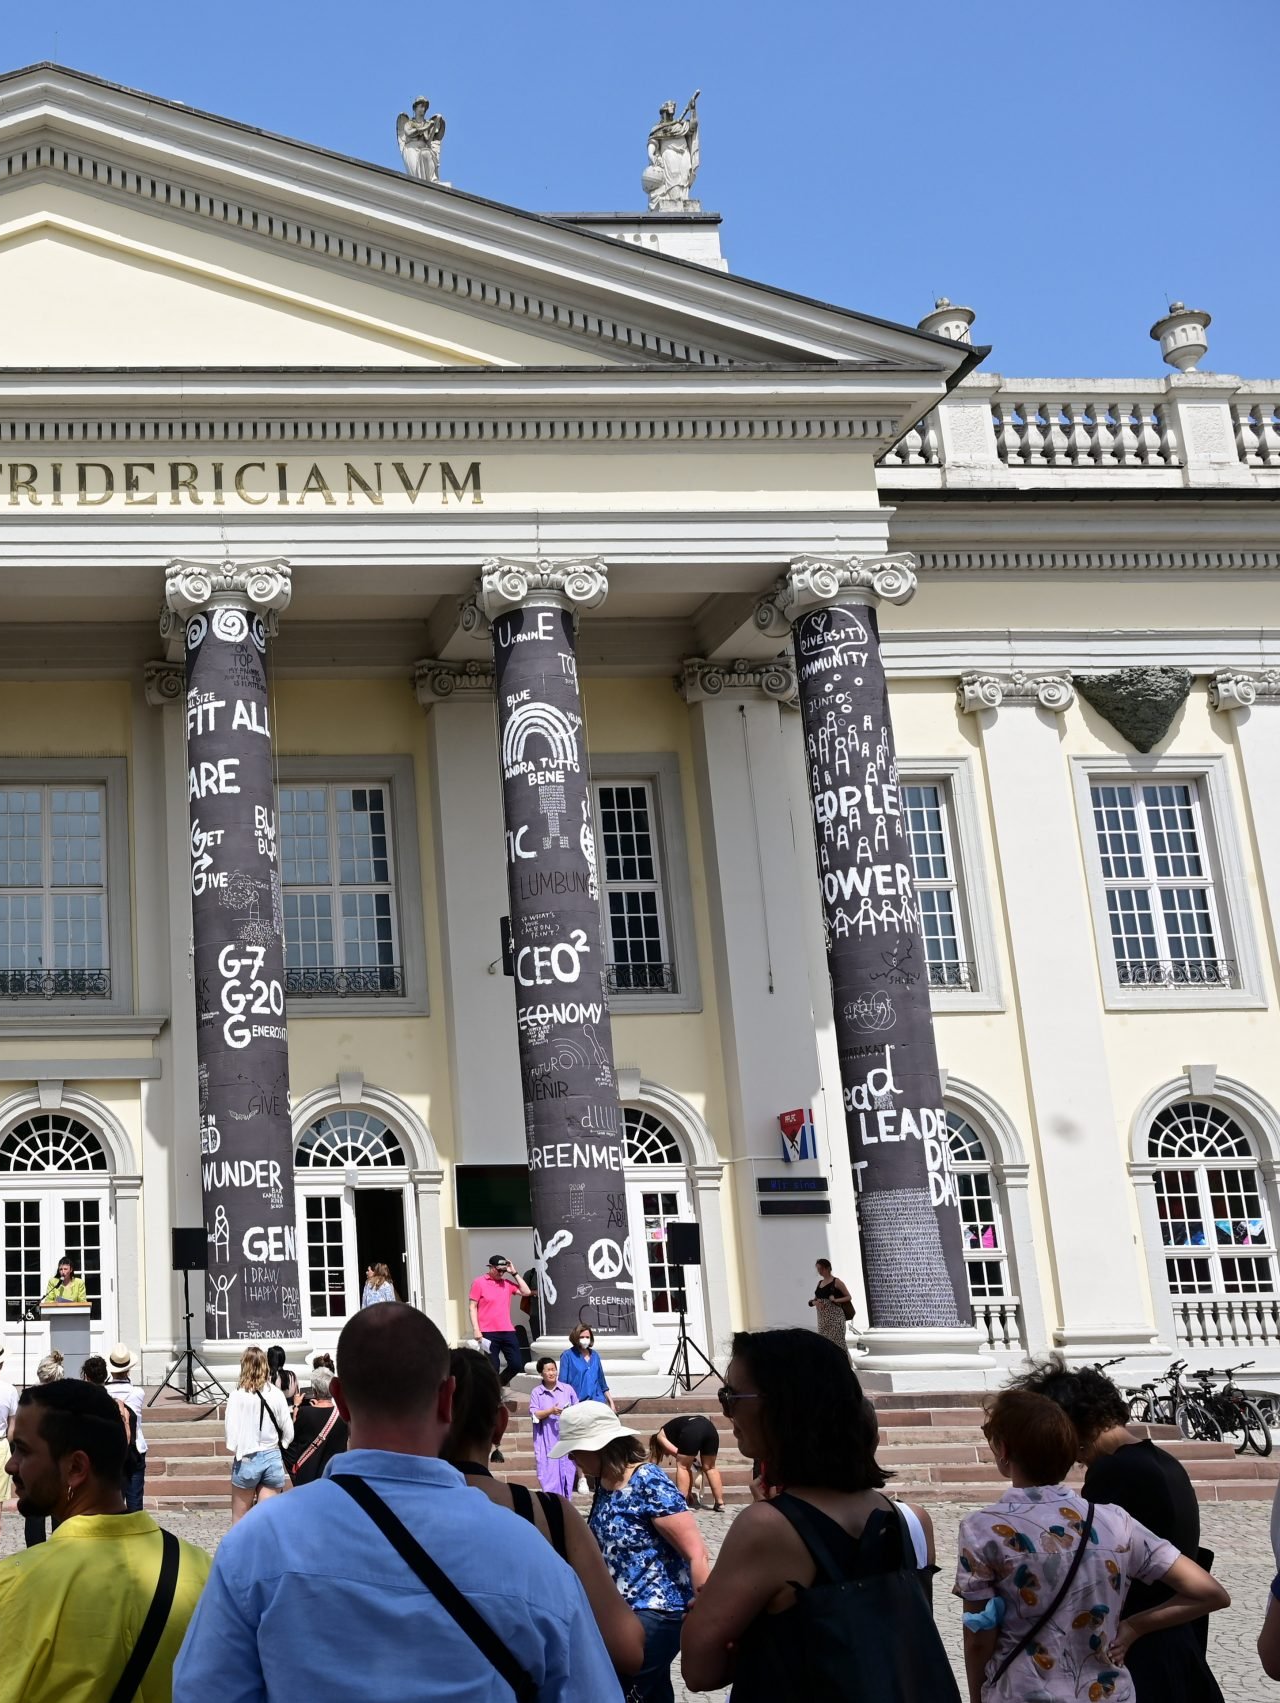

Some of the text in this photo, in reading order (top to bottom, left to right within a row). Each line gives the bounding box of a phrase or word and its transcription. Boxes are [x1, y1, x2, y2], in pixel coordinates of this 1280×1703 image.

[499, 612, 554, 647] UKRAINE
[506, 689, 531, 707] BLUE
[189, 758, 240, 802] ARE
[527, 770, 566, 786] BENE
[218, 944, 266, 980] G-7
[221, 979, 283, 1017] G-20
[248, 1095, 280, 1116] GIVE
[202, 1159, 283, 1192] WUNDER
[251, 1266, 280, 1285] DRAW
[250, 1285, 279, 1304] HAPPY
